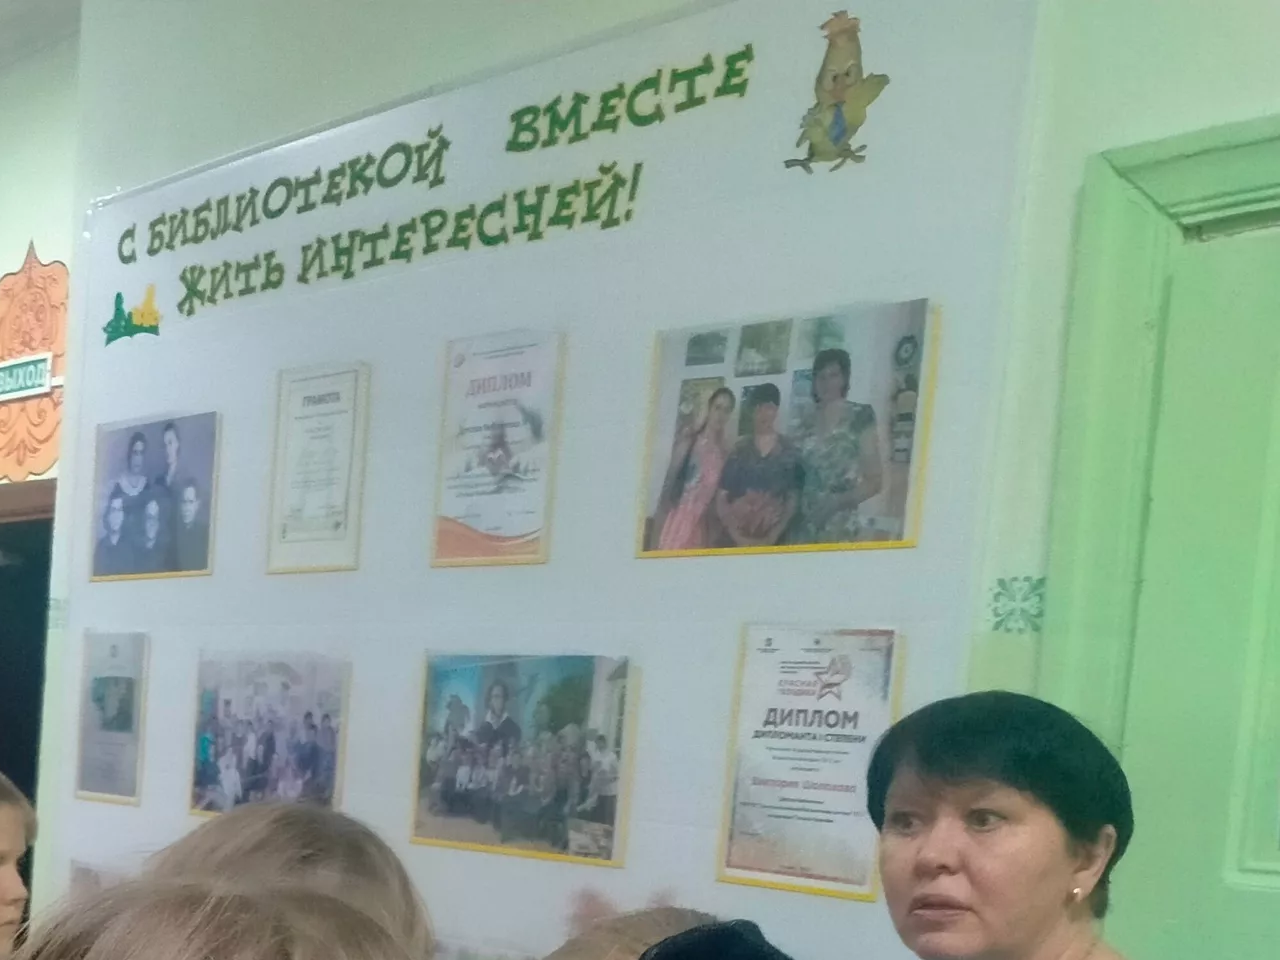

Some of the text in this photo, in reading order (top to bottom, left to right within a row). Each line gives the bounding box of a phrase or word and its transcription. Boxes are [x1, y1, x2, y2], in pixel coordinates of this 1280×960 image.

[117, 43, 755, 266] С БИБЛИОТЕКОЙ ВМЕСТЕ
[175, 163, 645, 315] ЖИТЬ ИНТЕРЕСНЕЙ!
[466, 372, 531, 397] ДИПЛОМ
[762, 707, 860, 730] ДИПЛОМ
